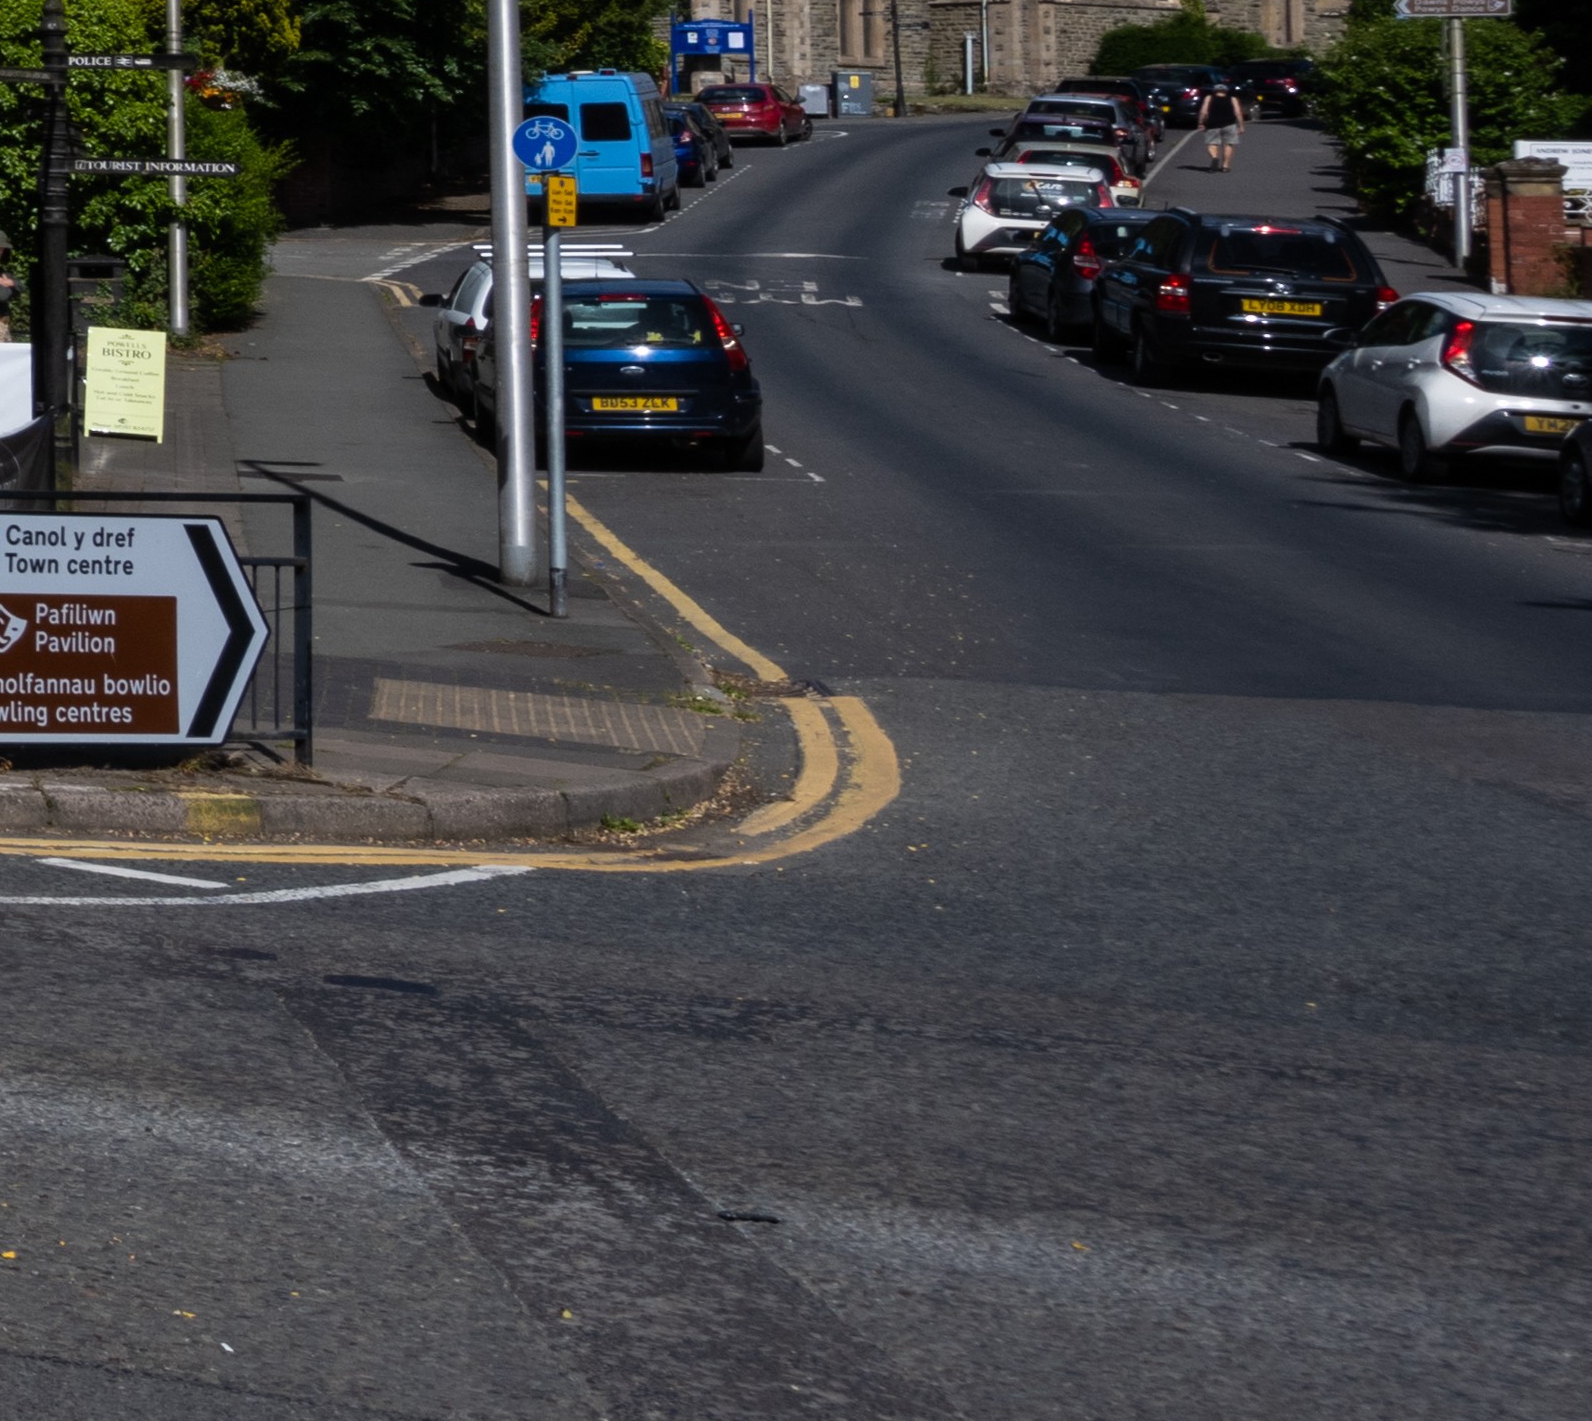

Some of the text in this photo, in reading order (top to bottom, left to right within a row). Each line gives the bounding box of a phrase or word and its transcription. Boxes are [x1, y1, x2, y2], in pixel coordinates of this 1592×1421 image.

[68, 57, 112, 67] POLICE
[1571, 148, 1592, 156] JONE
[86, 161, 236, 174] TOURIST INFORMATION
[102, 348, 152, 360] BISTRO
[5, 524, 136, 551] Canol y dref
[5, 552, 134, 576] Town centre
[35, 602, 117, 626] Pafiliwn
[35, 631, 116, 653] Pavilion
[103, 673, 171, 696] bowlio
[55, 702, 133, 724] centres
